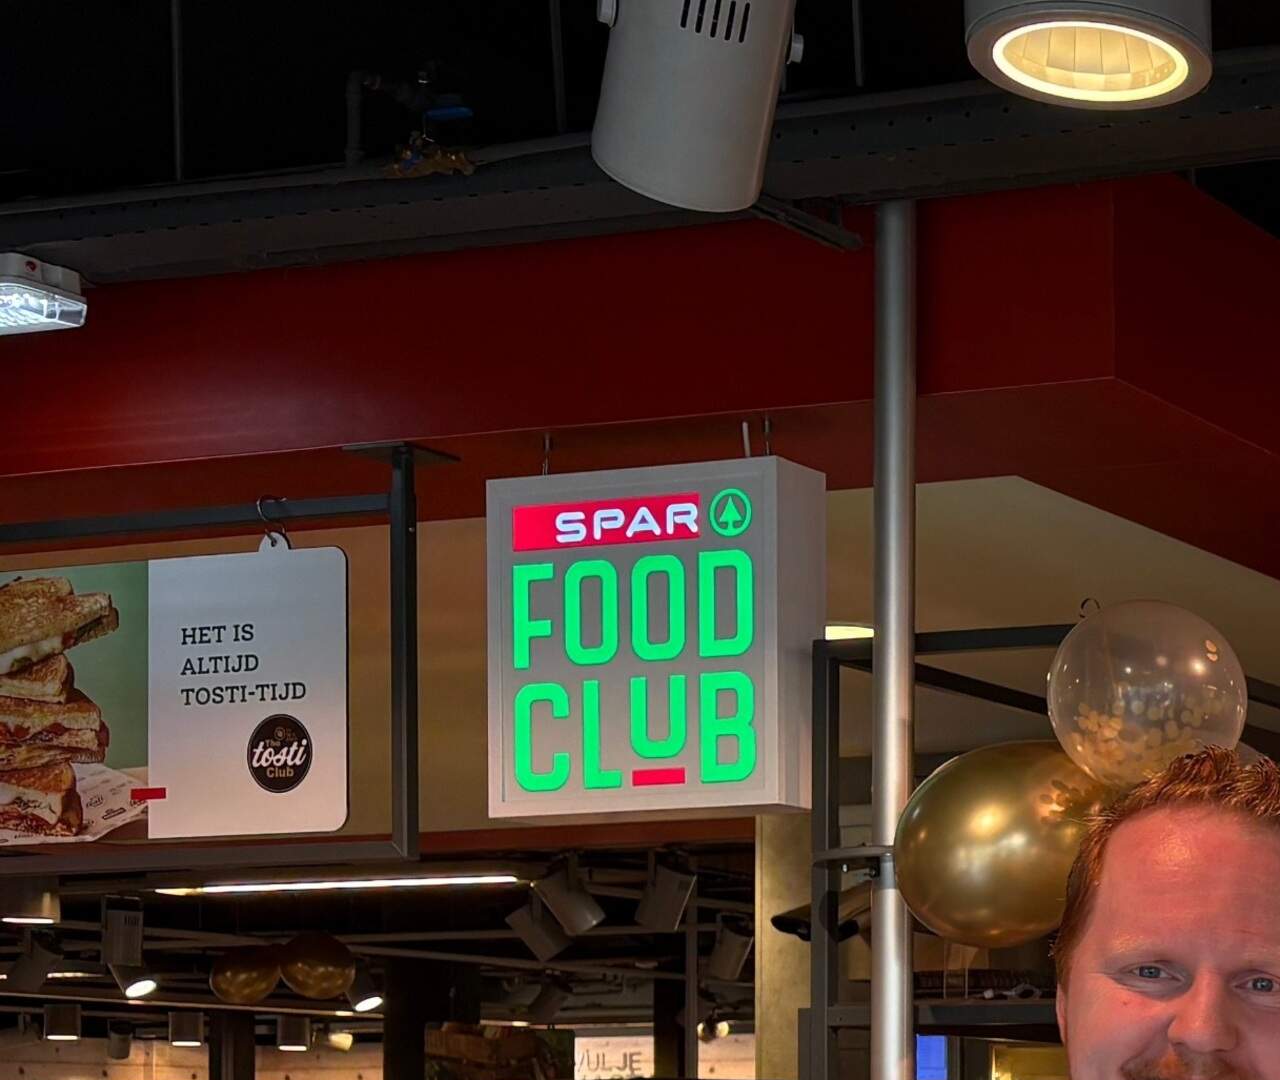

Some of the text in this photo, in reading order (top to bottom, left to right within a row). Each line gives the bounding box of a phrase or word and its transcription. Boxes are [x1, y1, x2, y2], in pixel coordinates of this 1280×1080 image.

[555, 502, 699, 544] SPAR
[512, 548, 756, 671] FOOD
[181, 623, 255, 646] HET IS
[180, 653, 260, 676] ALTIJD
[180, 681, 307, 706] TOSTI-TIJD
[514, 670, 758, 793] CLUB
[252, 738, 308, 768] tosti
[266, 767, 294, 779] Club
